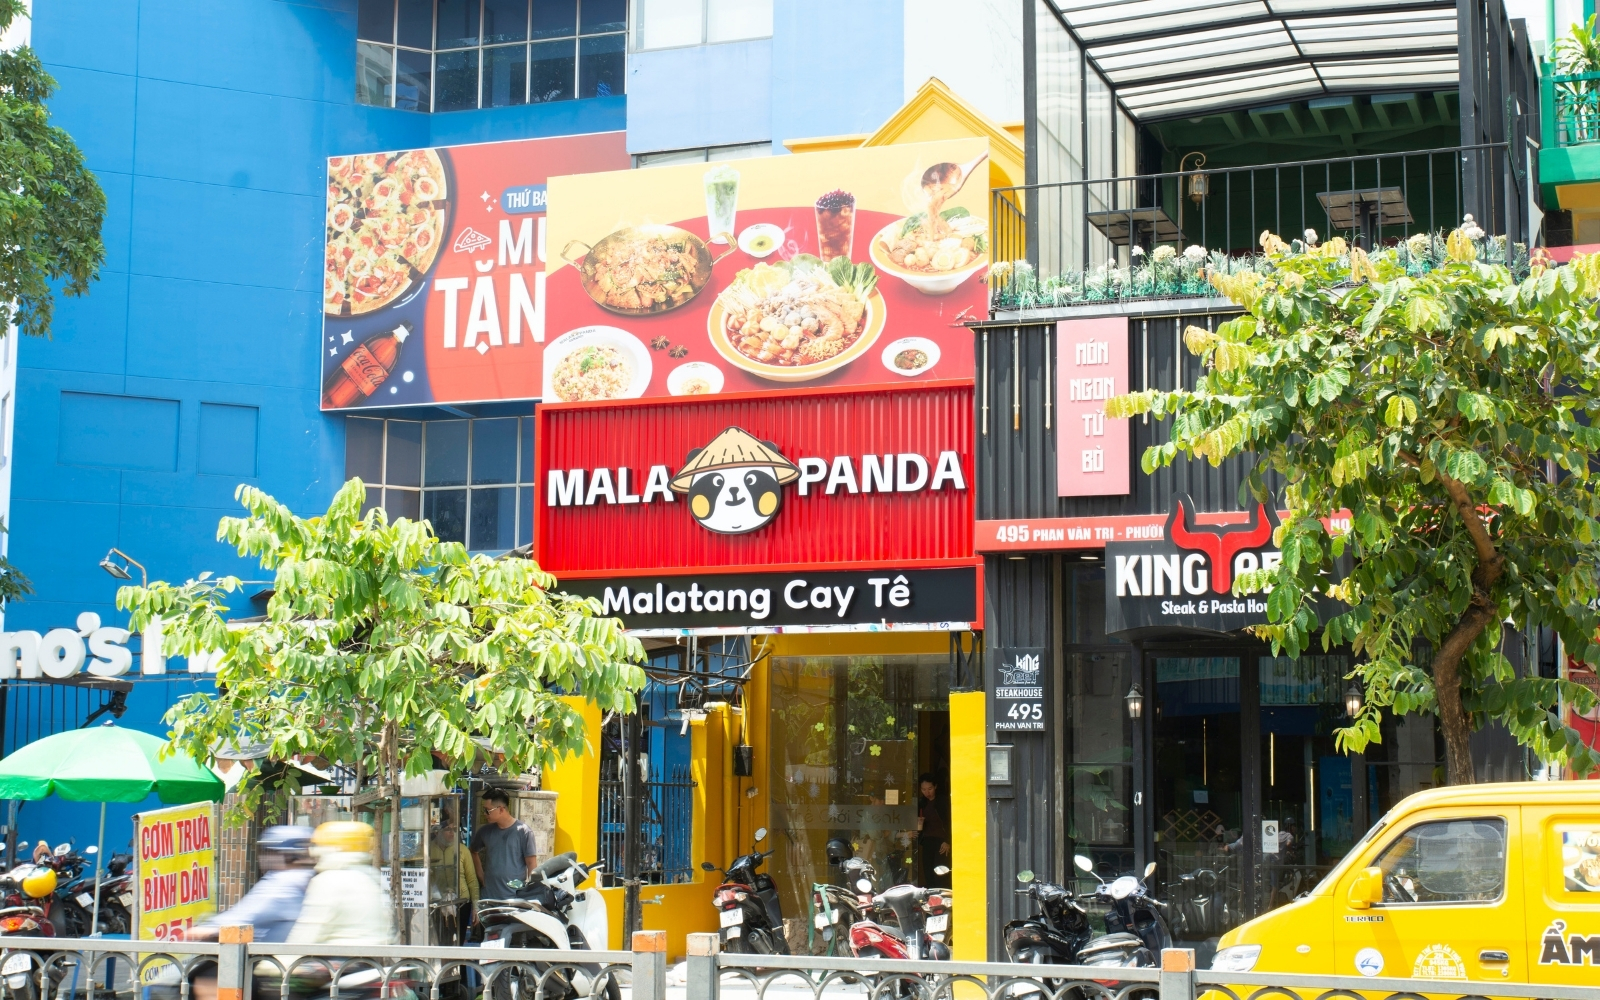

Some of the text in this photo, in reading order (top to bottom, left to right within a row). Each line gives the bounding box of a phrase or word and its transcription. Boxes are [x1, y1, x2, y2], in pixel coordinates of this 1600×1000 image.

[506, 188, 531, 208] THỨ
[1075, 338, 1109, 365] MÓN
[1069, 377, 1115, 401] NGON
[1081, 445, 1105, 472] BÒ
[547, 450, 966, 506] MALA PANDA
[996, 524, 1030, 543] 495
[1033, 529, 1065, 541] PHAN
[1067, 526, 1092, 541] VĂN
[602, 574, 911, 619] Malatang Cay Tê
[1161, 600, 1196, 614] Steak
[1198, 600, 1209, 613] &
[1211, 599, 1246, 613] Pasta
[995, 688, 1043, 697] STEAKHOUSE
[1007, 702, 1043, 720] 495
[141, 813, 212, 862] CƠM TRƯA
[143, 861, 209, 913] BÌNH DÂN
